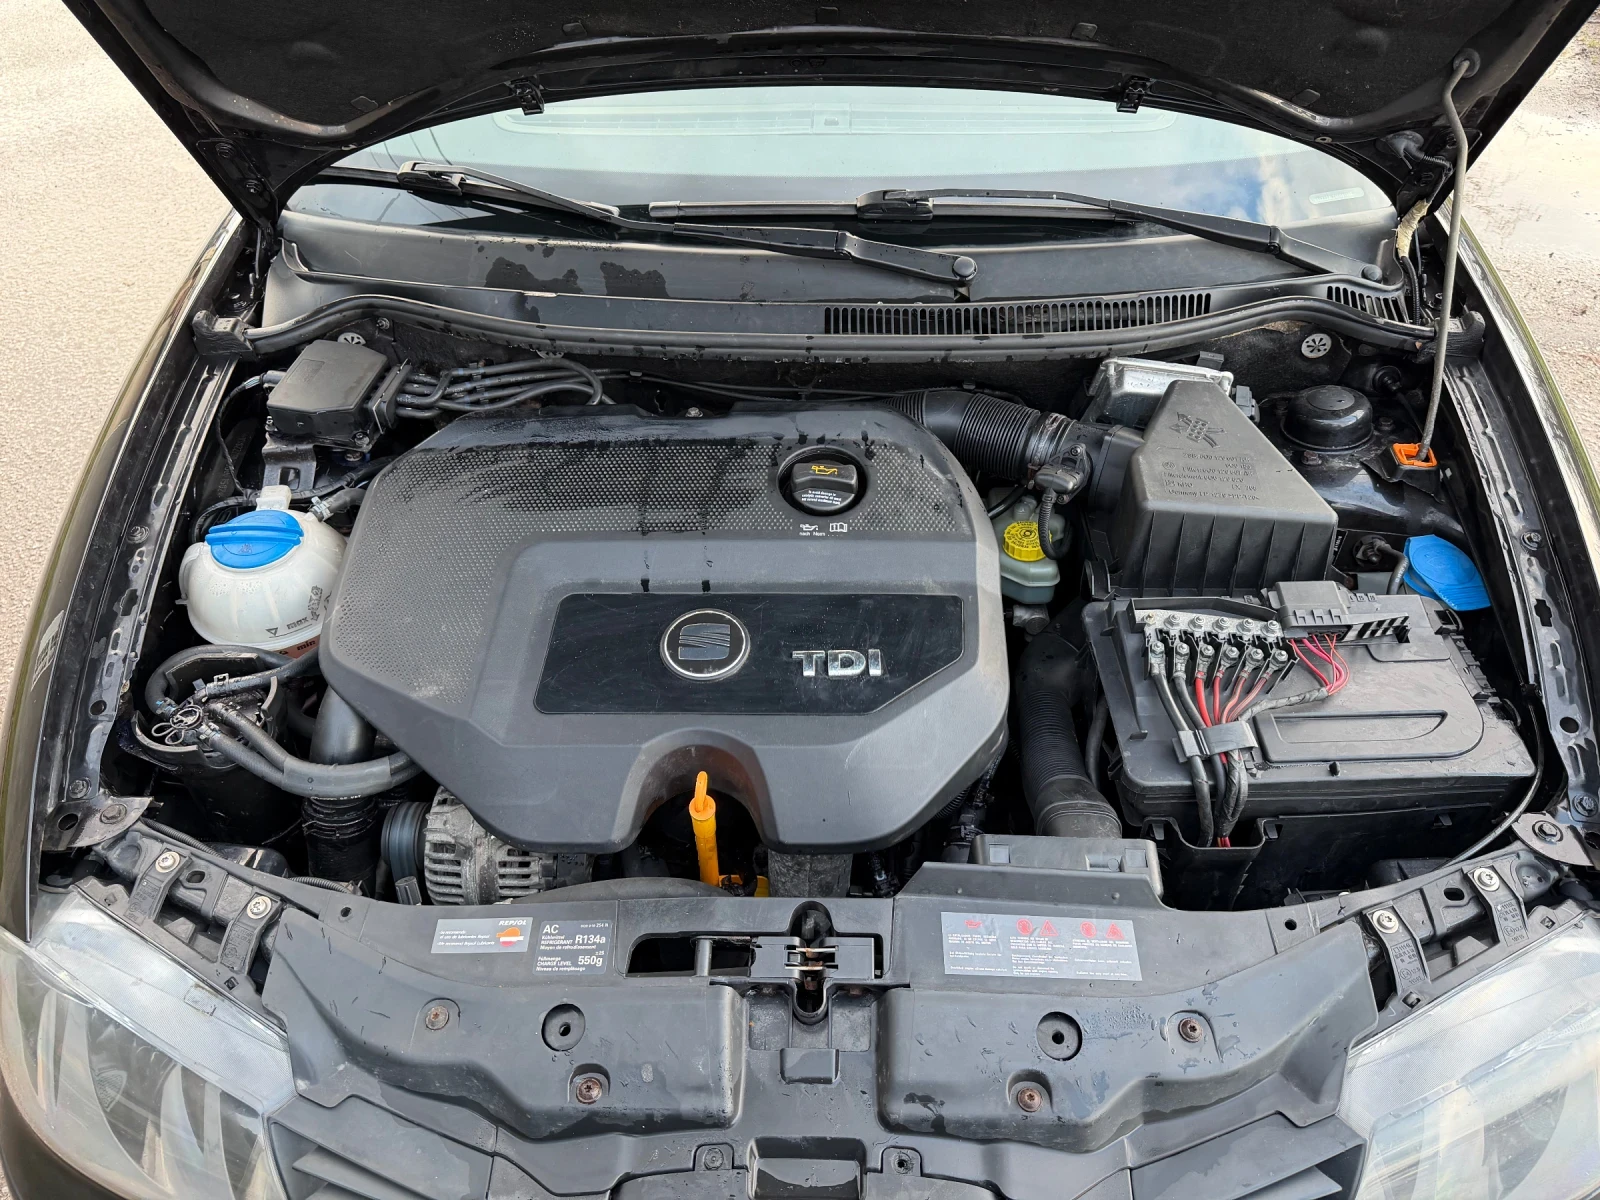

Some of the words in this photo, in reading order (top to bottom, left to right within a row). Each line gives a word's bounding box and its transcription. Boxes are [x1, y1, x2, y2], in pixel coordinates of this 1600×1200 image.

[286, 616, 309, 630] max
[297, 640, 316, 651] min
[791, 648, 882, 677] TDI
[542, 924, 560, 934] AC
[575, 934, 606, 944] R134a
[578, 955, 603, 967] 550g
